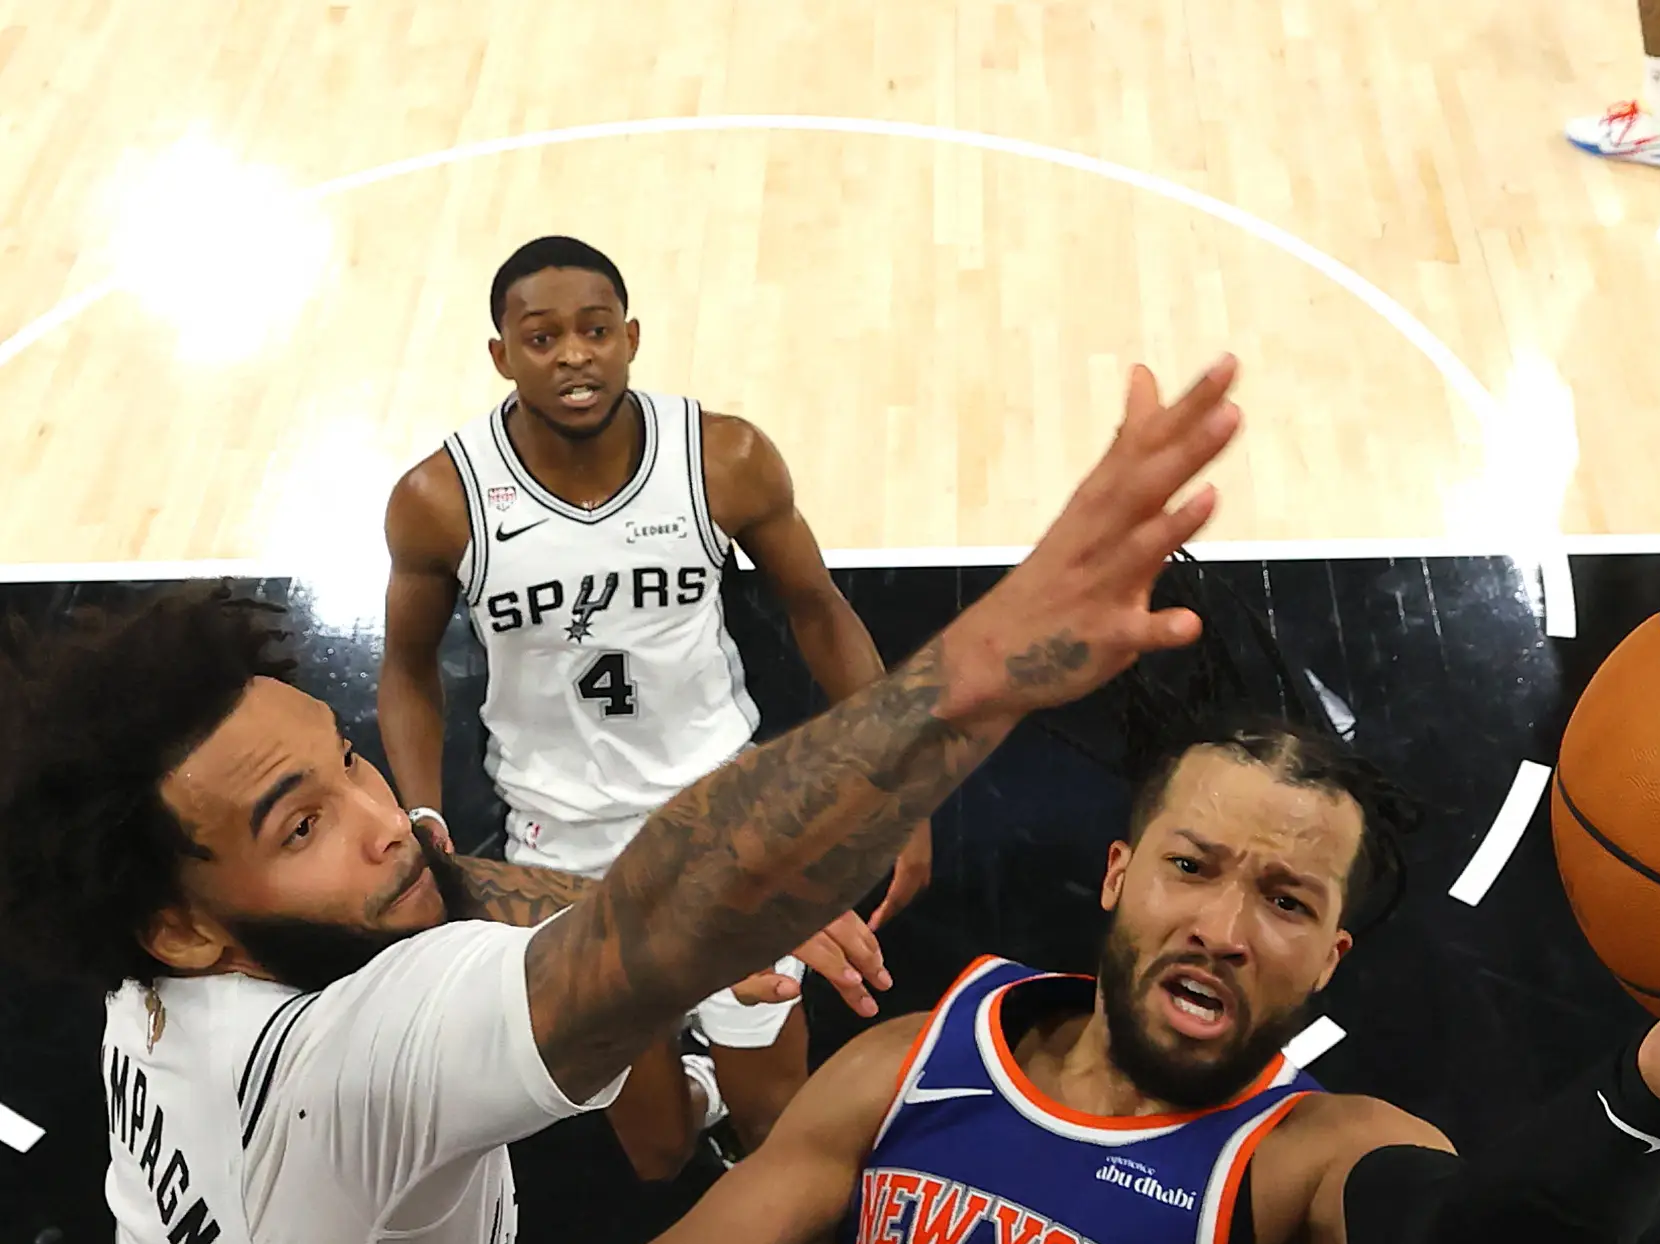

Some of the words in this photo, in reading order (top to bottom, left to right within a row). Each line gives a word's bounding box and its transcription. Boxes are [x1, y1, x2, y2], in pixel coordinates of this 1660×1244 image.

[487, 566, 707, 643] SPURS
[574, 649, 638, 719] 4
[1096, 1164, 1133, 1188] abu
[1133, 1176, 1197, 1211] dhabi
